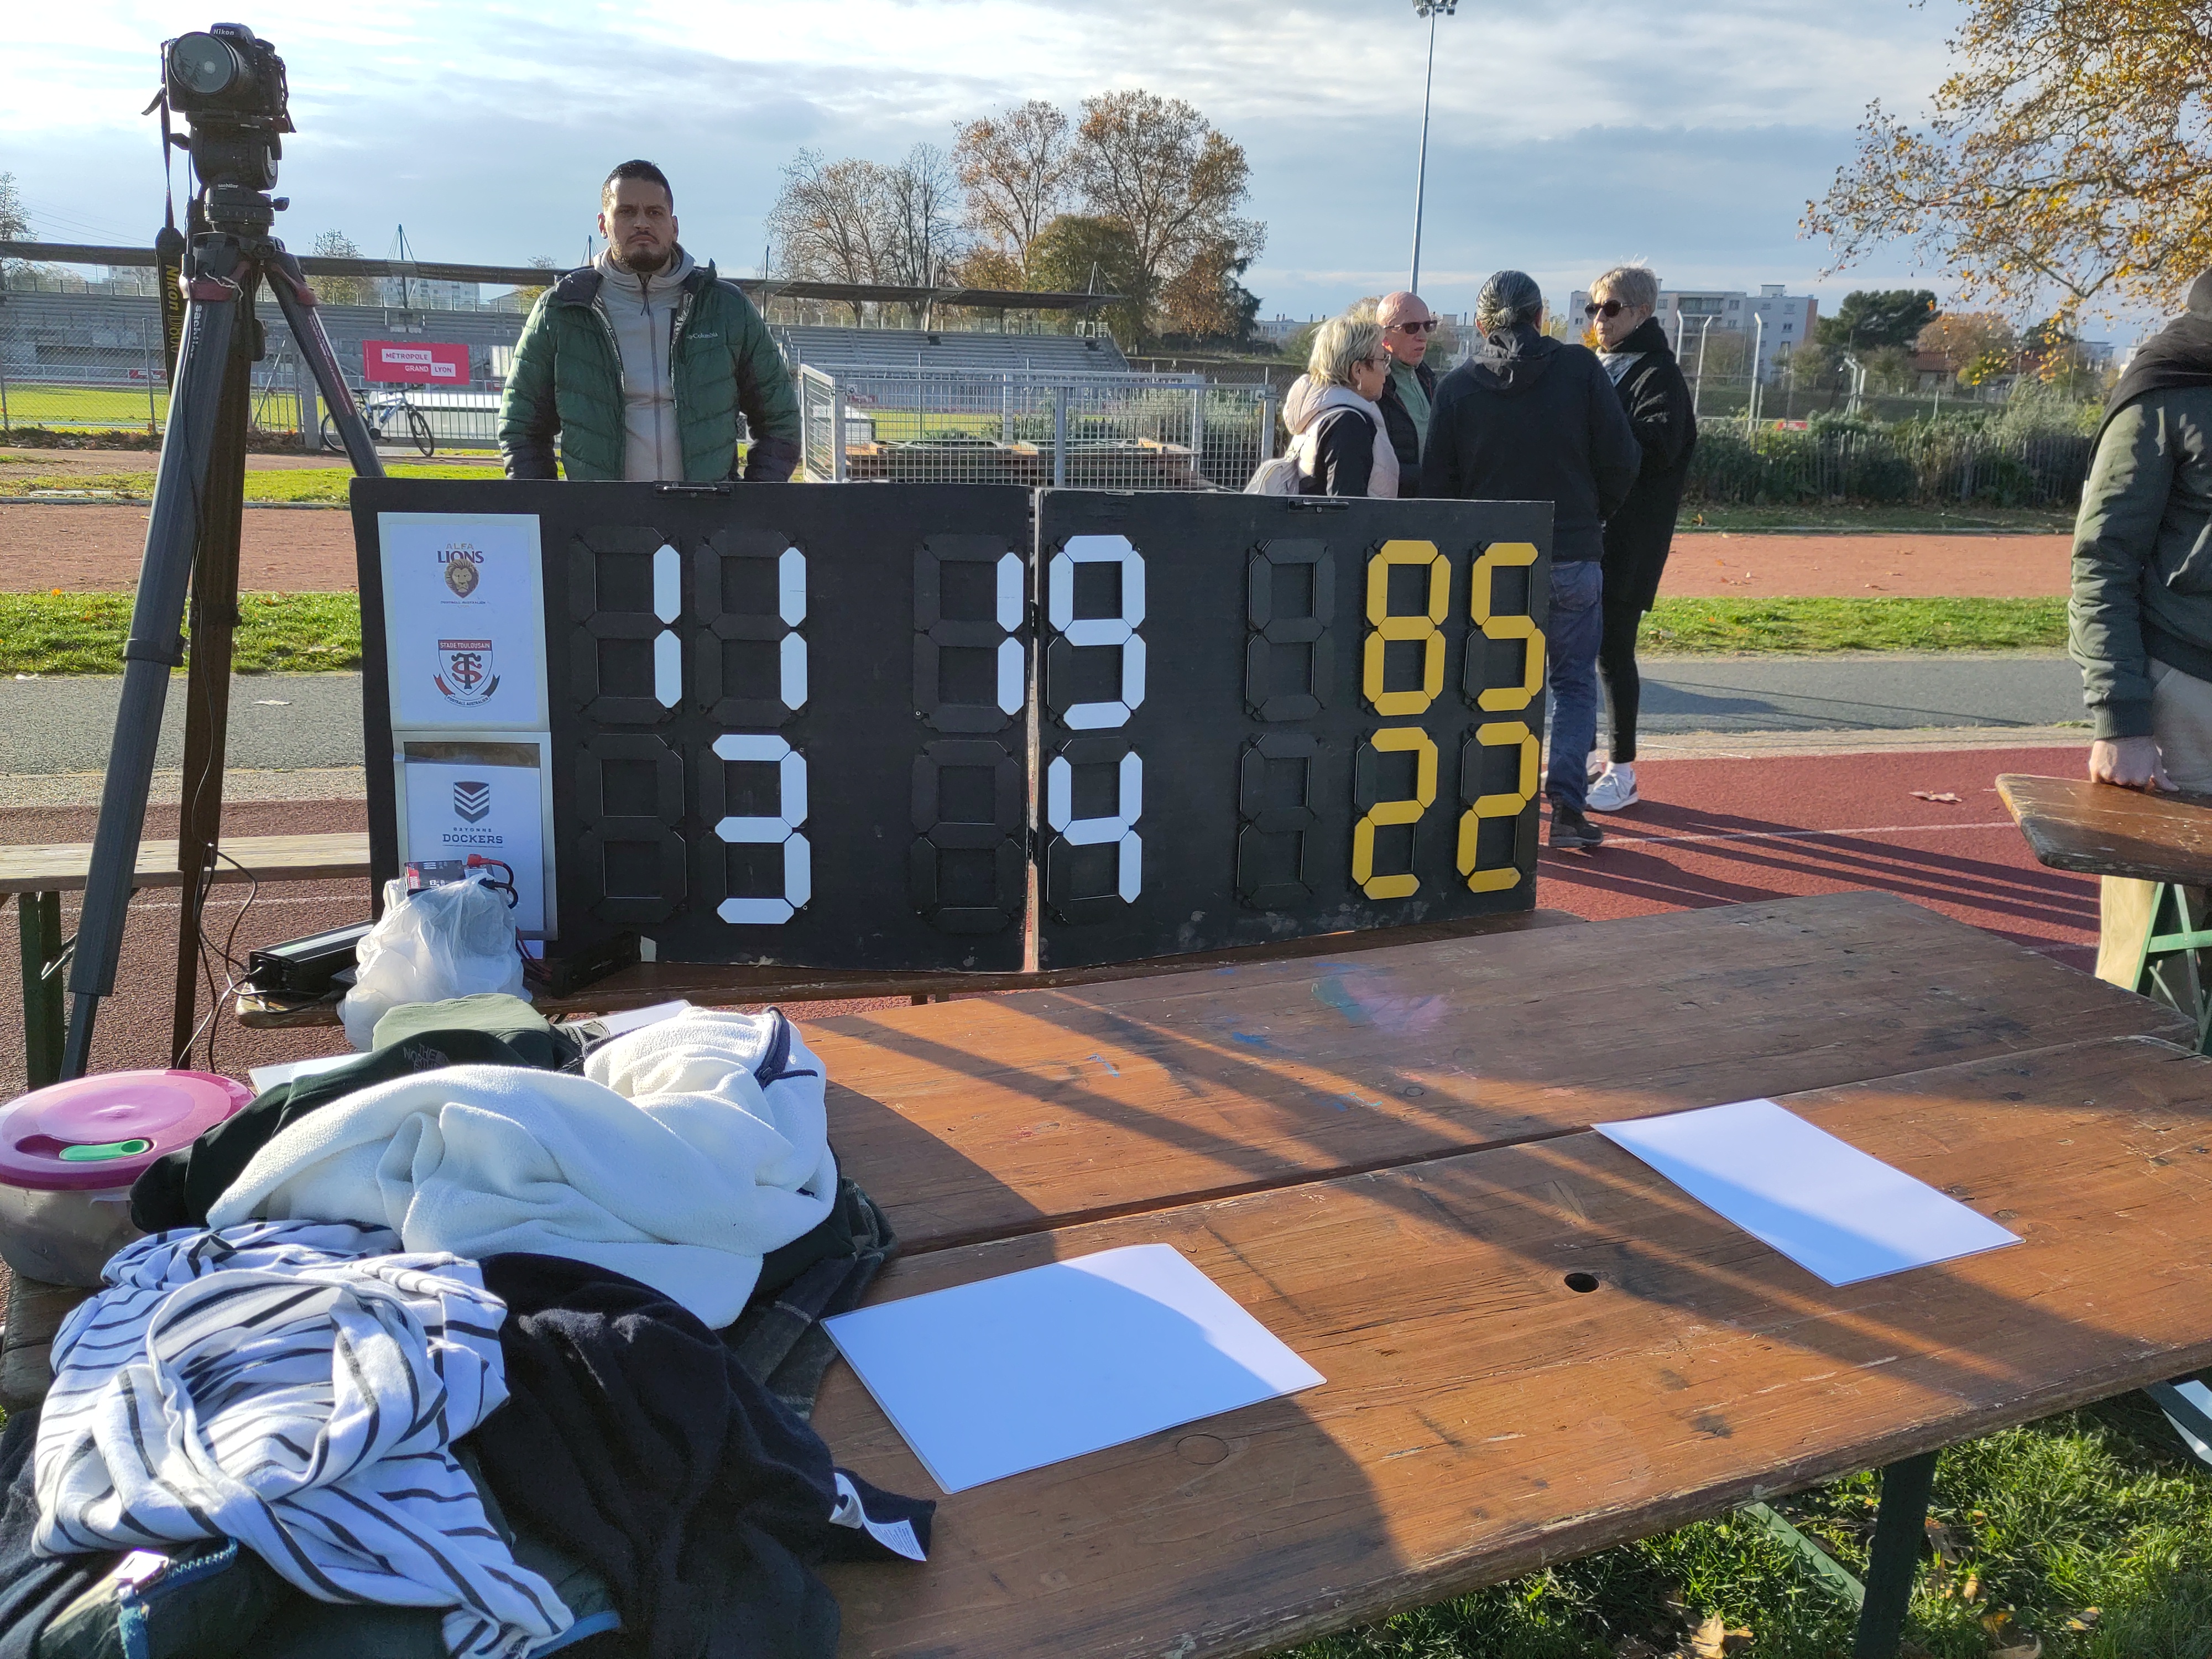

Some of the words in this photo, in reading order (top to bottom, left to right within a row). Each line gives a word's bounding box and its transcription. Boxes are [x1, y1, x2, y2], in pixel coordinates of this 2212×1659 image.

[166, 264, 179, 311] Nikon
[437, 550, 484, 564] LIONS
[1363, 540, 1546, 716] 85
[447, 696, 466, 706] FOOTBALL
[713, 735, 811, 924] 3
[1047, 752, 1142, 904] 4
[1352, 721, 1539, 900] 22
[442, 834, 503, 844] DOCKERS
